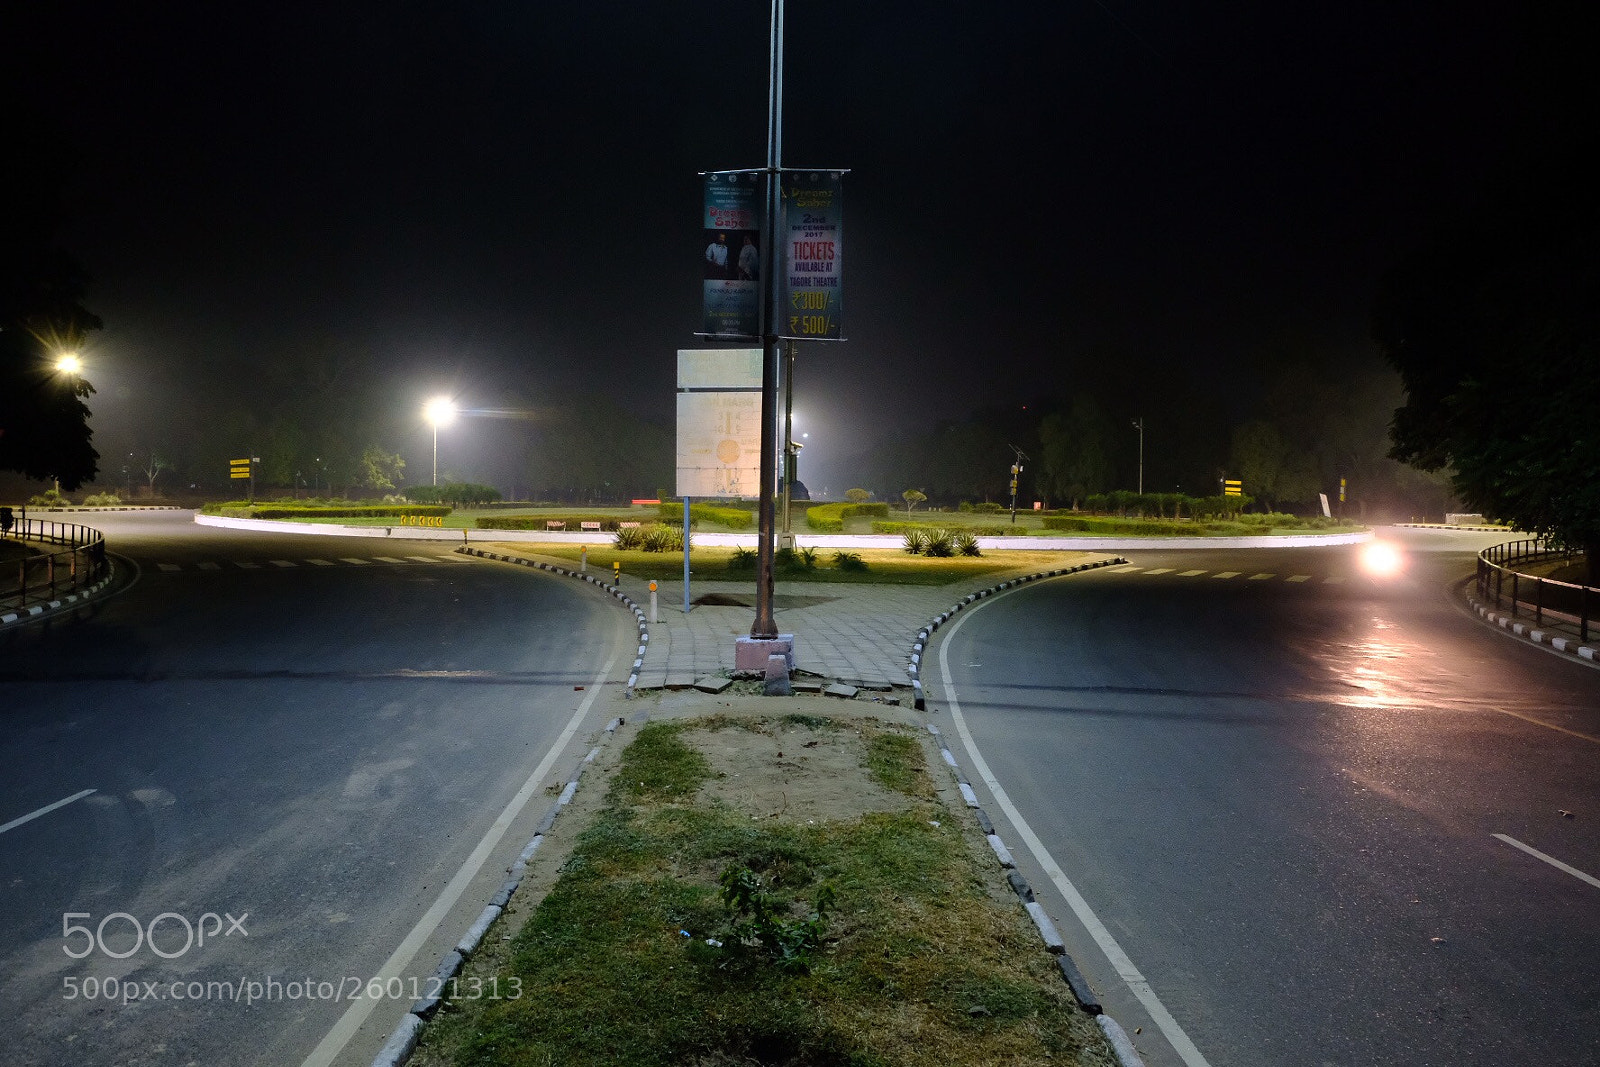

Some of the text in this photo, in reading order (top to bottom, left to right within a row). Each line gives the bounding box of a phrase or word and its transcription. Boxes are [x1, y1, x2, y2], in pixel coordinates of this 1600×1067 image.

[803, 213, 826, 223] 2nd
[793, 242, 835, 260] TICKETS
[795, 262, 833, 272] AVAILABLE AT
[790, 277, 838, 287] TAGORE THEATRE
